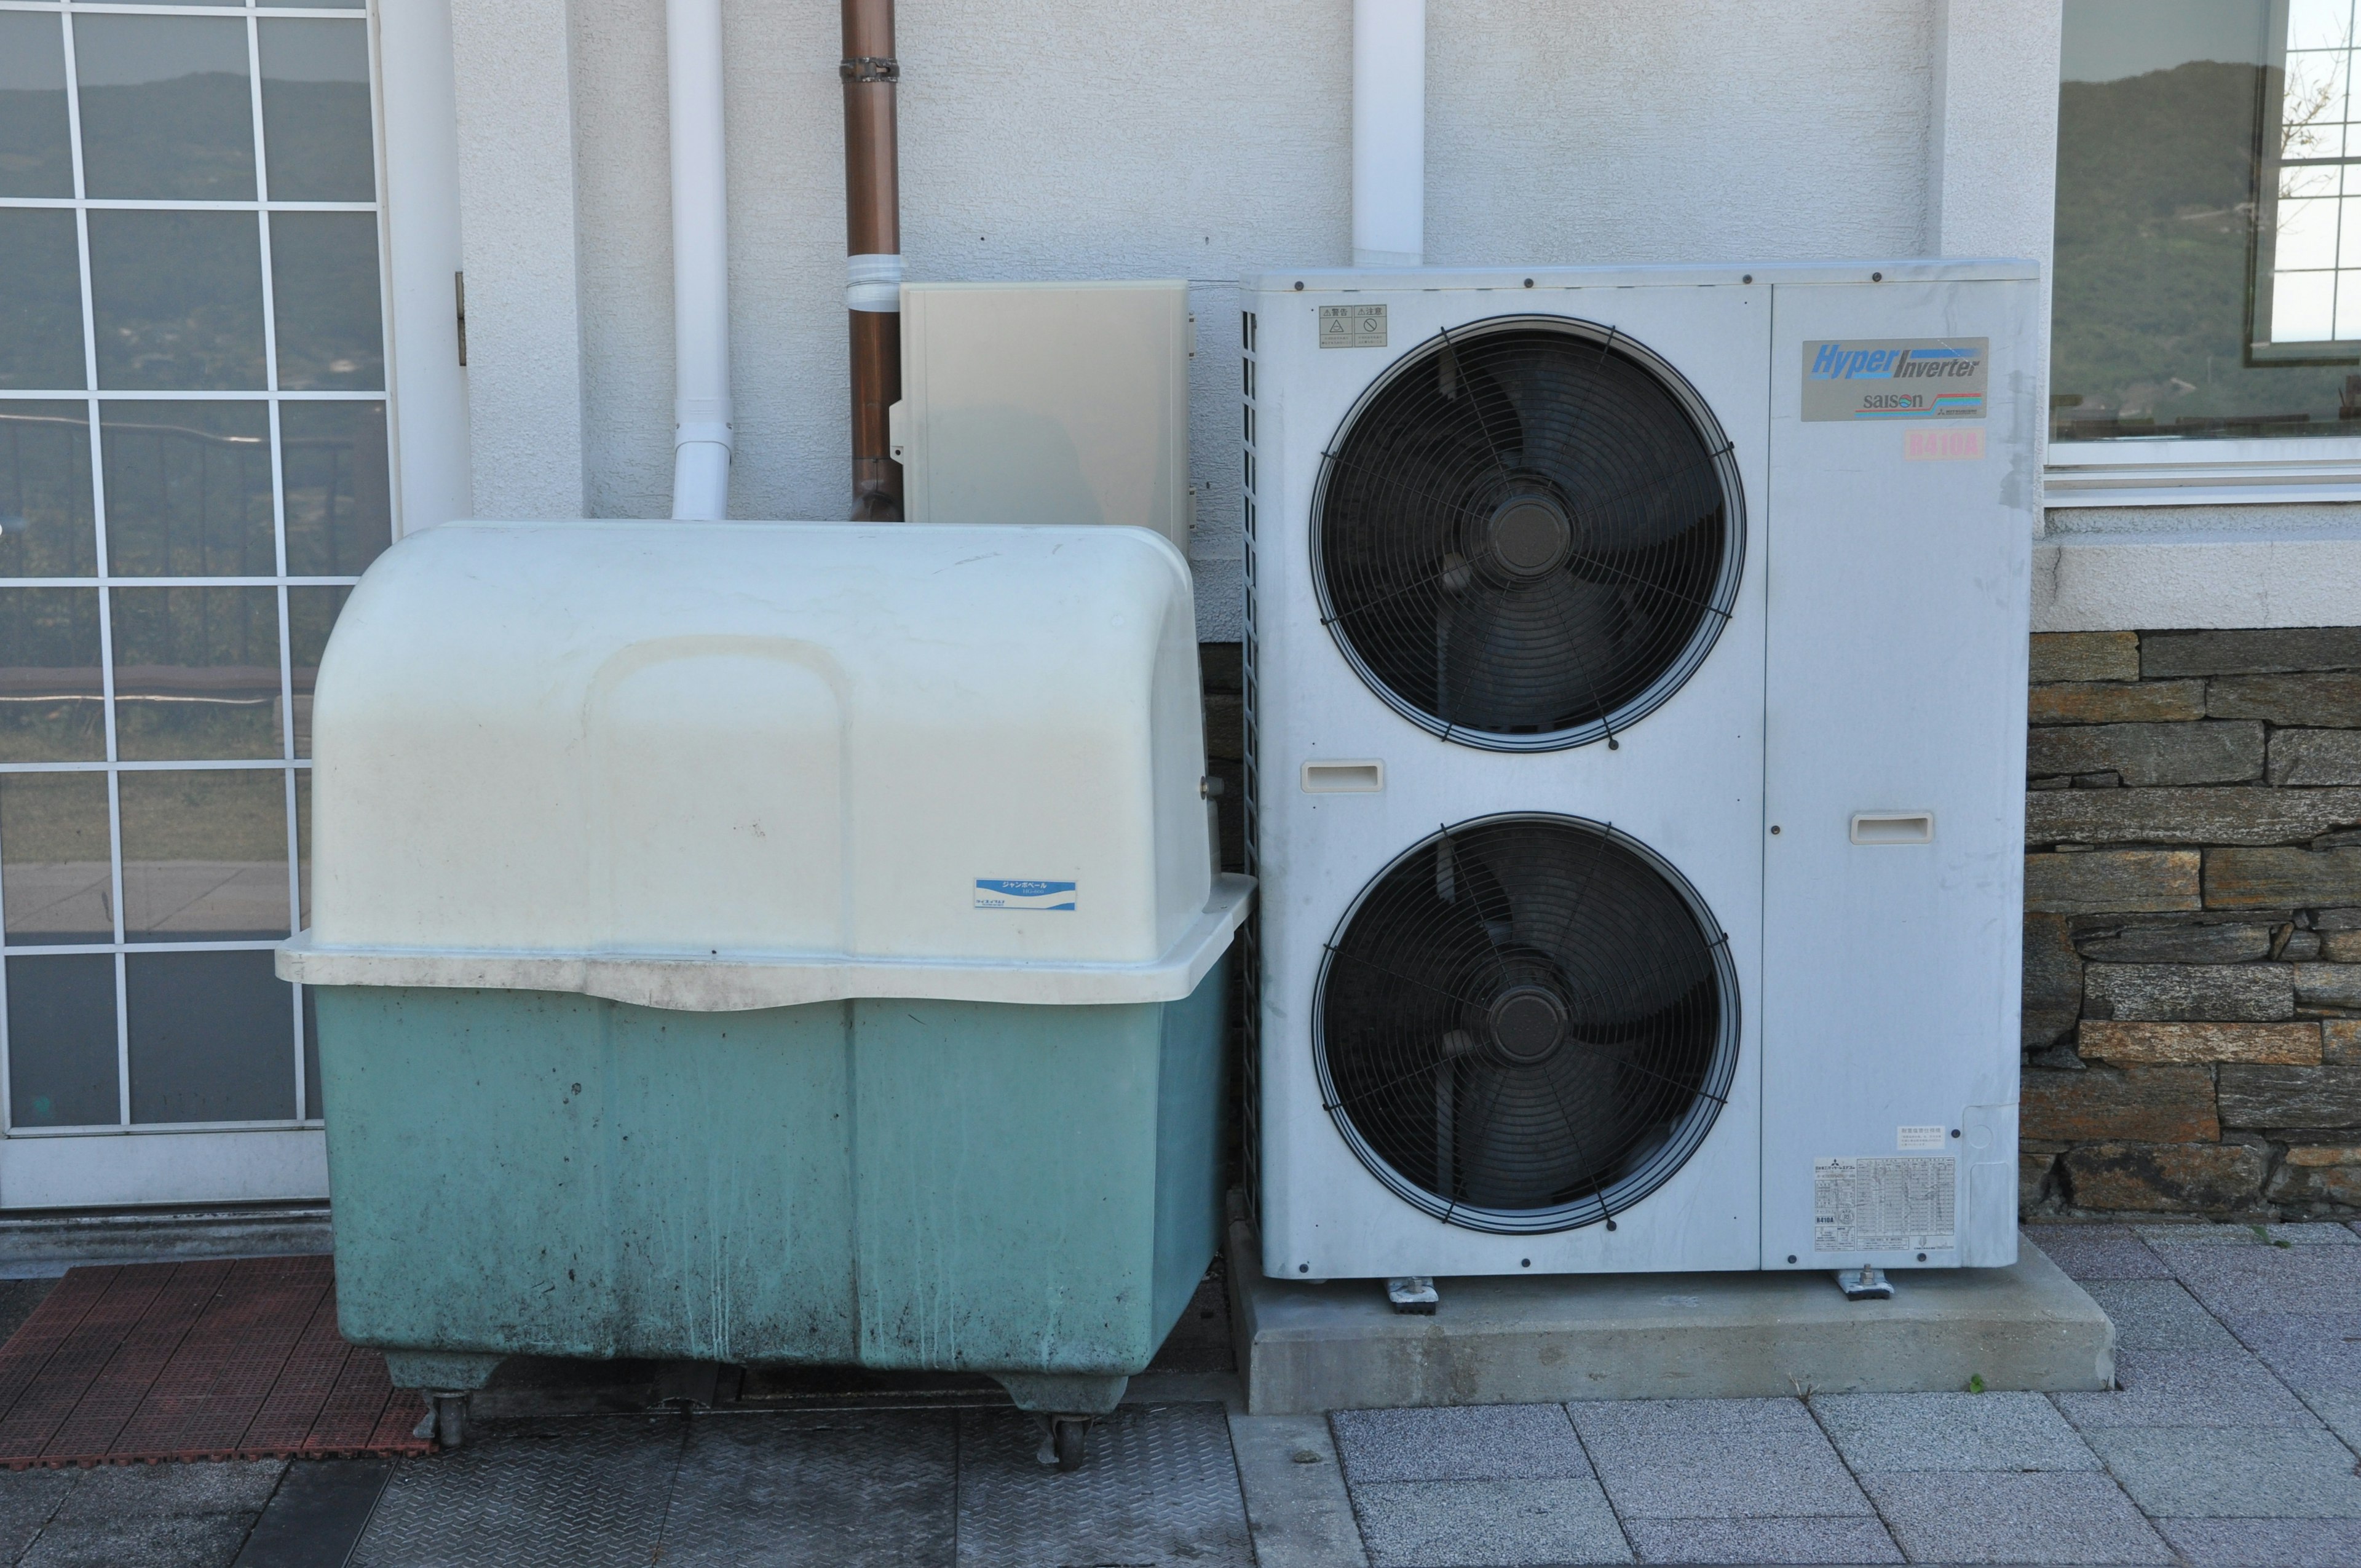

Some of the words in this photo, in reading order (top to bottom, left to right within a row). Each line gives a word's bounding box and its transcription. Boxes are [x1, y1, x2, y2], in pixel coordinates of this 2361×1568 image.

[1811, 344, 1900, 379] Hyper
[1894, 350, 1980, 378] Inverter
[1863, 394, 1923, 408] saison
[1909, 432, 1979, 456] R410A
